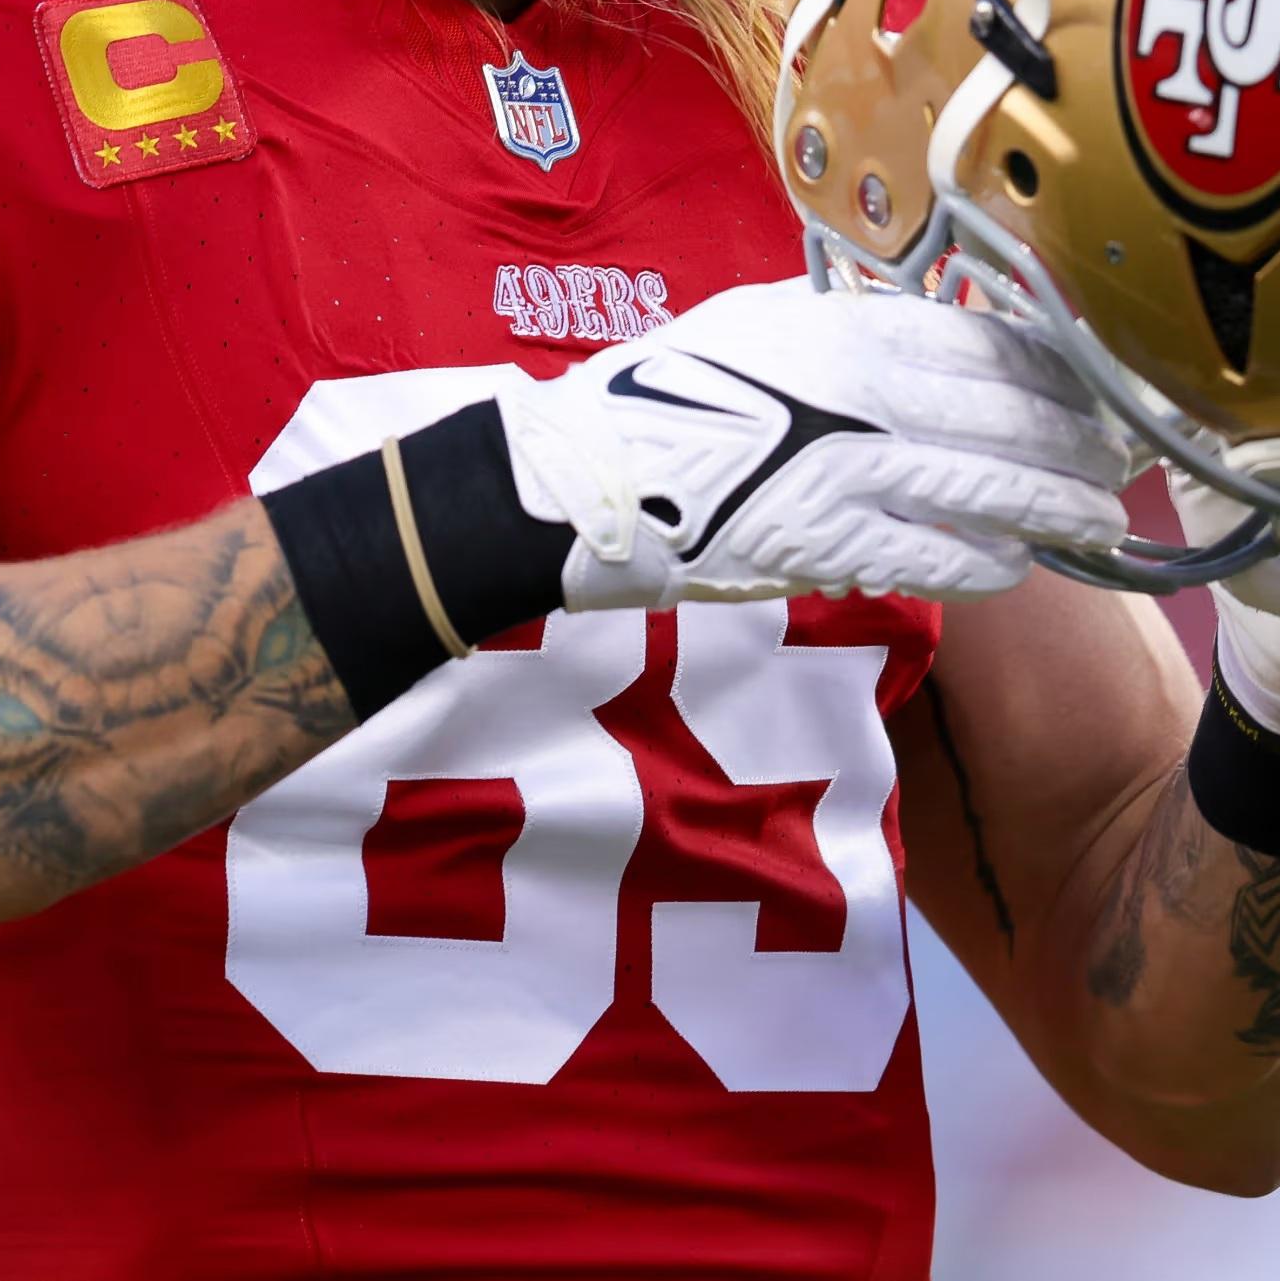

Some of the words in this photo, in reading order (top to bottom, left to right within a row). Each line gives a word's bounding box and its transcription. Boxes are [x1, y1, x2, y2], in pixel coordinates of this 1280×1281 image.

[508, 104, 567, 149] NFL
[493, 264, 674, 342] 49ERS
[224, 362, 912, 1093] 89
